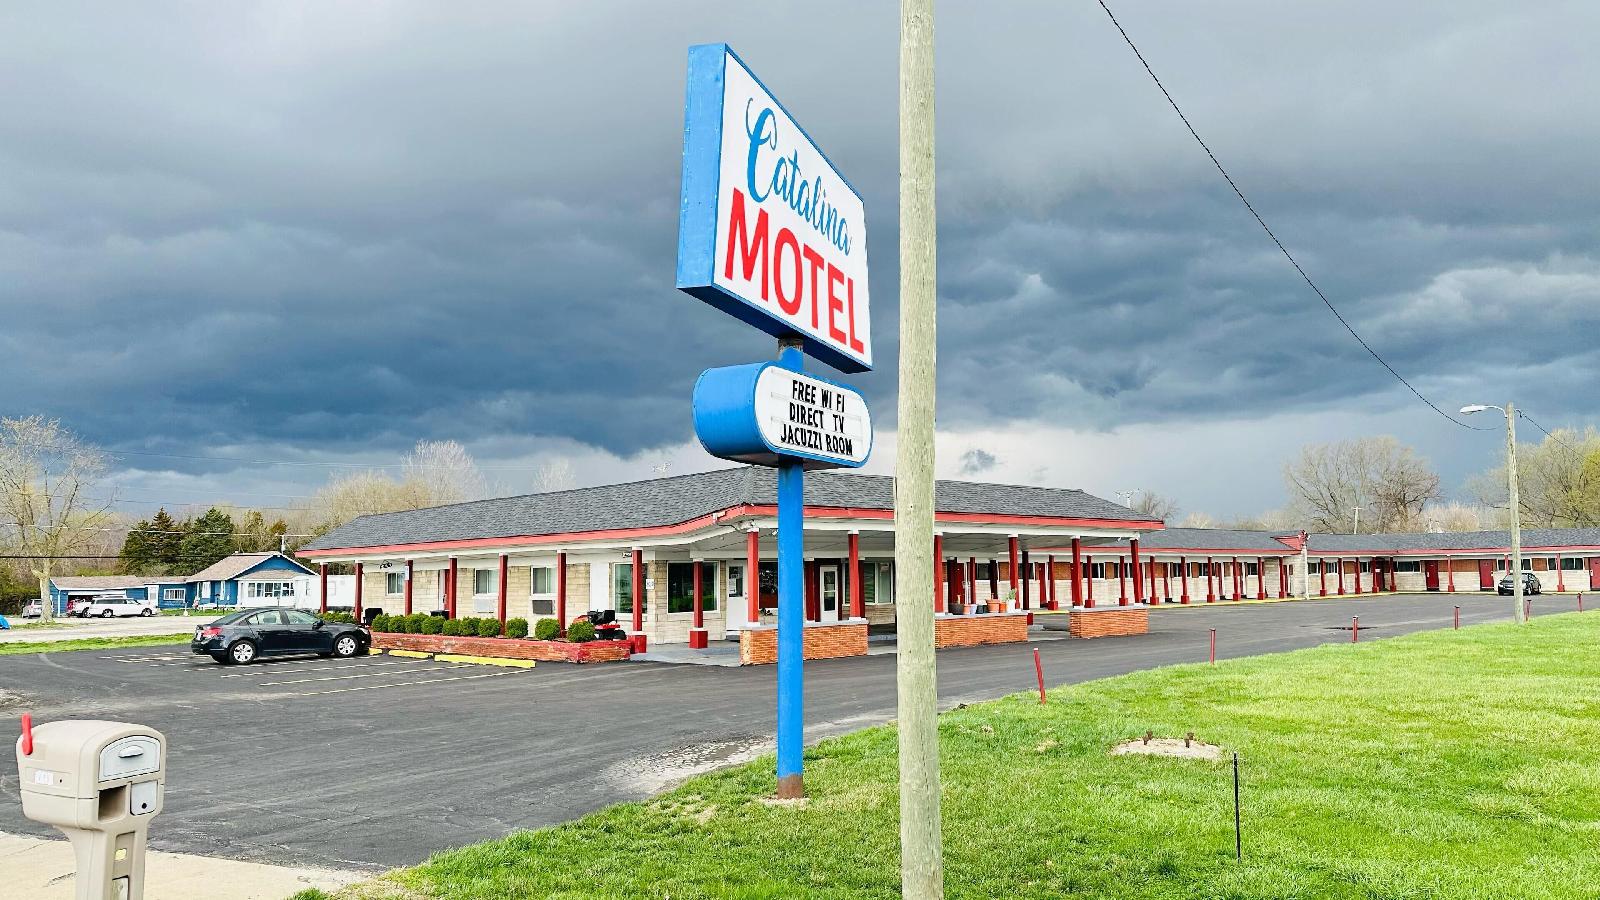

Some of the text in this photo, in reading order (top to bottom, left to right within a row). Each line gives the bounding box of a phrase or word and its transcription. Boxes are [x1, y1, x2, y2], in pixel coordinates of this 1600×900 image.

[745, 98, 852, 256] Catalina
[724, 187, 864, 354] MOTEL
[792, 380, 844, 413] FREE WI FI
[789, 402, 844, 433] DIRECT TV
[781, 424, 852, 455] JACUZZI ROOM
